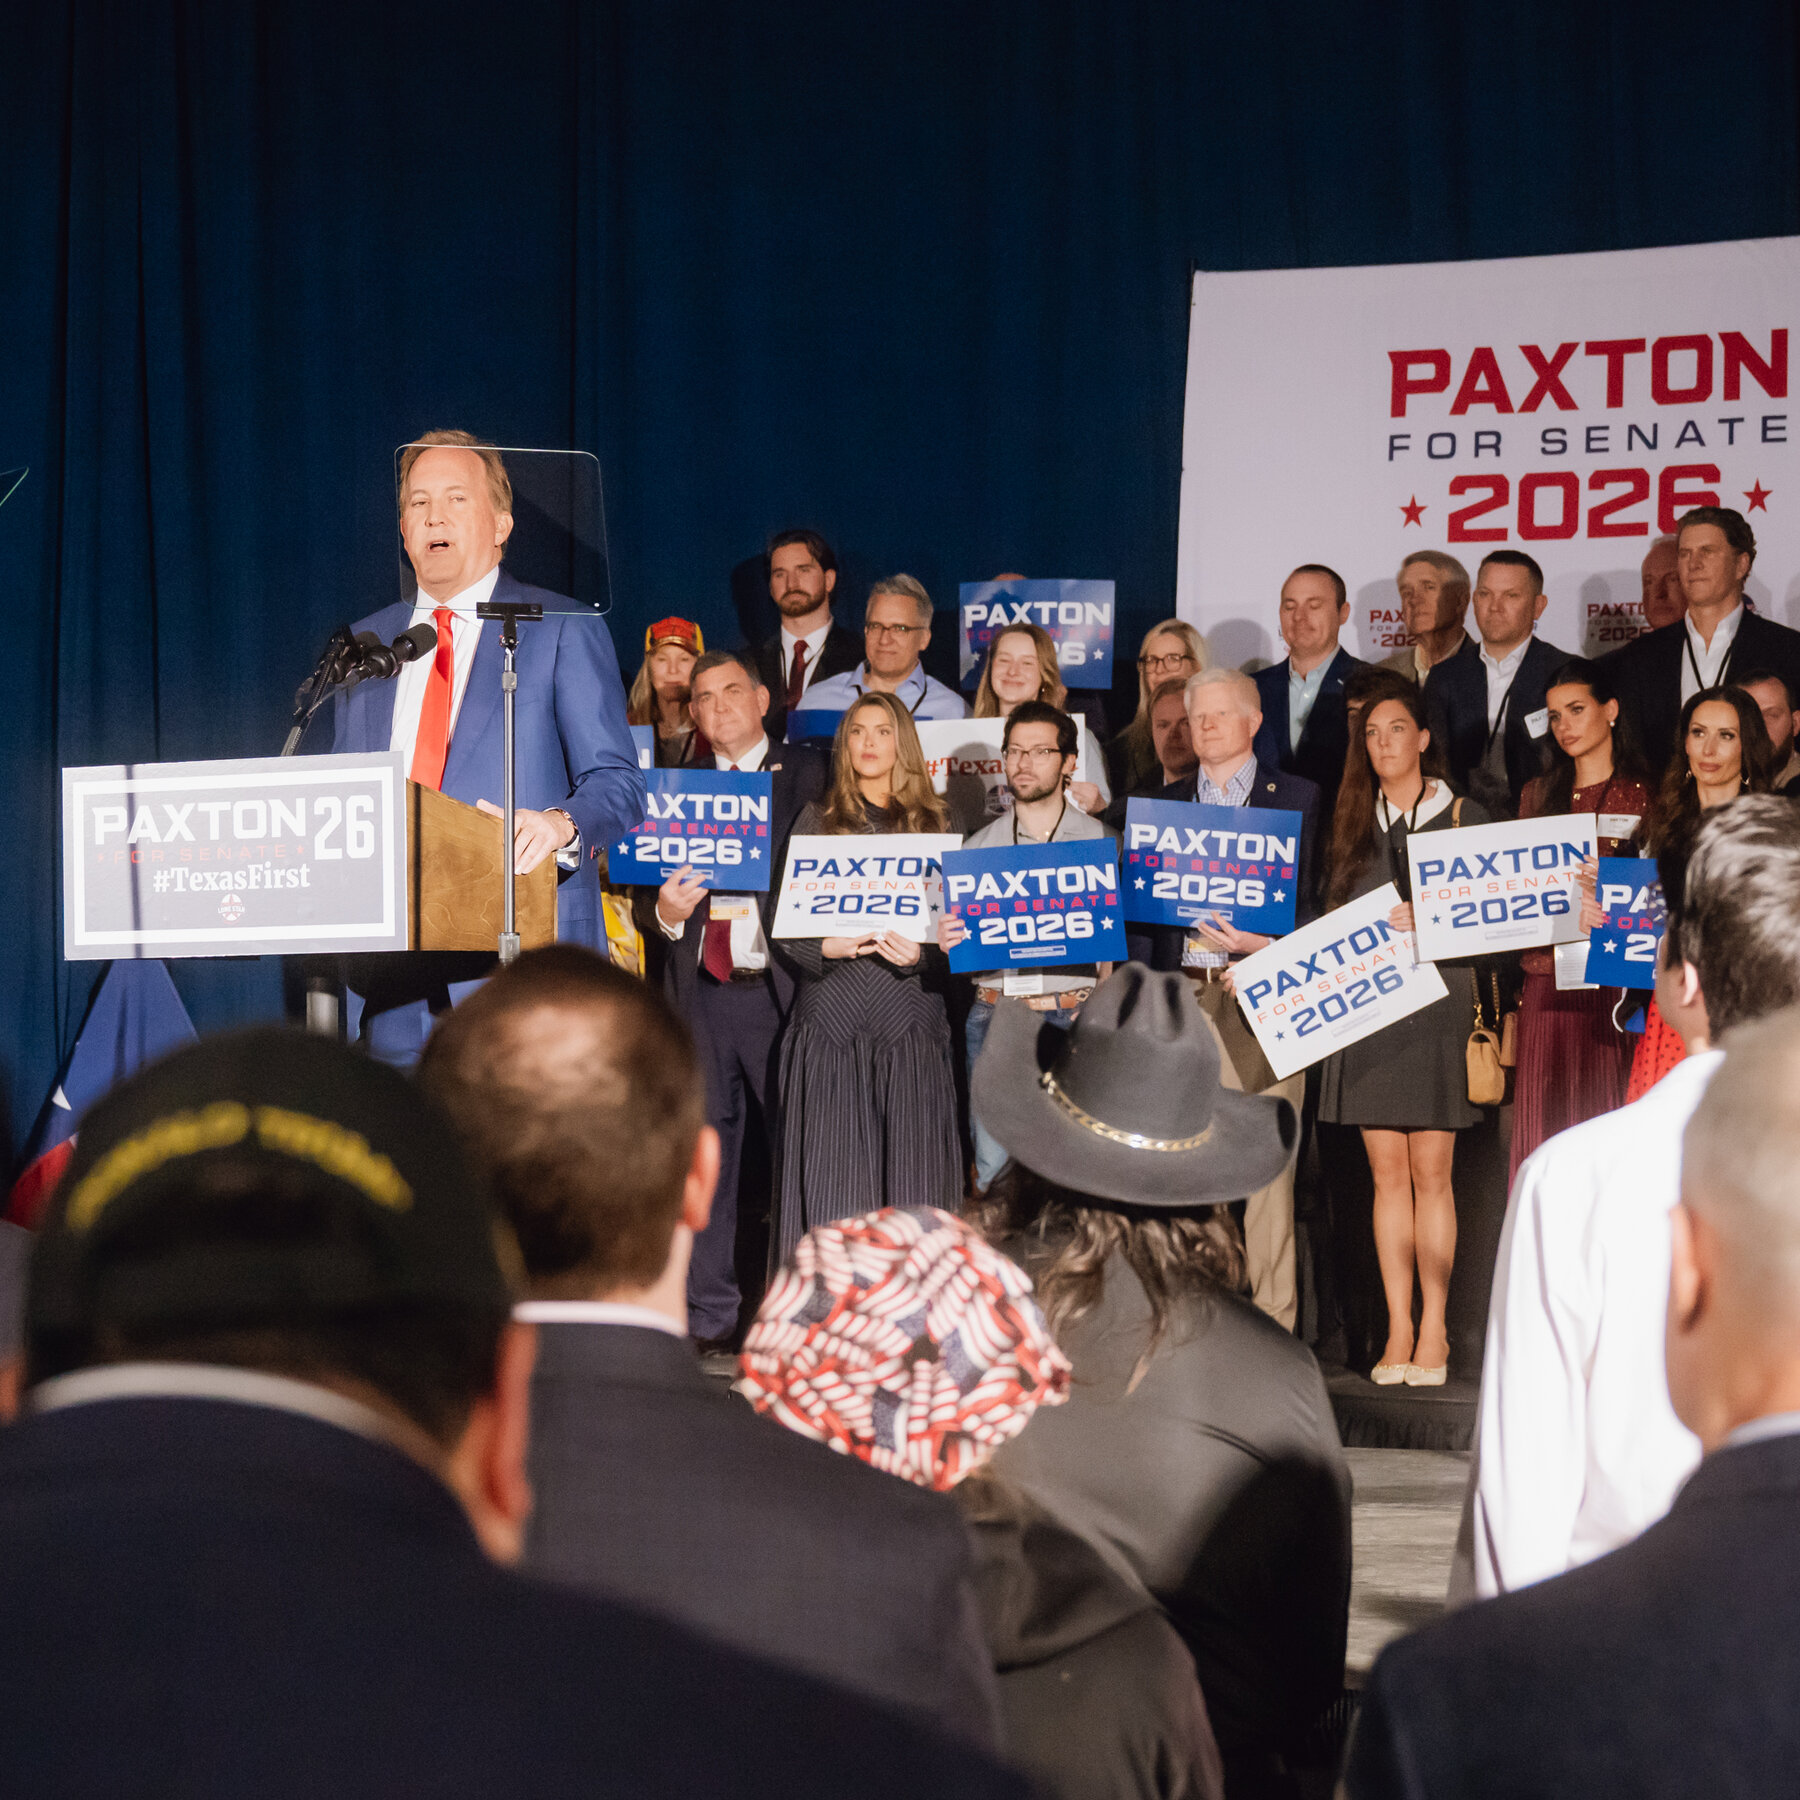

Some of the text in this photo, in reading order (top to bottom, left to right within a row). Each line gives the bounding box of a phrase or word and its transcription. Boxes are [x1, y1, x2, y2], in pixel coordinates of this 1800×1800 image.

[1388, 328, 1789, 418] PAXTON
[1388, 415, 1788, 461] FOR SENATE
[1447, 463, 1721, 543] 2026
[963, 601, 1111, 628] PAXTON
[1369, 609, 1404, 623] PAX
[1380, 633, 1417, 648] 202
[926, 756, 1004, 777] #Texa
[646, 792, 769, 822] AXTON
[92, 794, 375, 861] PAXTON 26
[669, 822, 768, 837] SENATE
[113, 844, 287, 865] FOR SENATE
[635, 836, 743, 865] 2026
[1130, 823, 1296, 864] PAXTON
[153, 861, 311, 893] #TexasFirst
[792, 857, 942, 878] PAXTON
[1129, 853, 1293, 879] FOR SENATE
[1416, 841, 1590, 886] PAXTON
[789, 881, 836, 892] FOR
[947, 863, 1117, 902] PAXTON
[1152, 871, 1266, 907] 2026
[1421, 871, 1575, 902] FOR SENAT
[810, 894, 921, 916] 2026
[951, 893, 1118, 916] FOR SENATE
[1450, 889, 1570, 928] 2026
[978, 911, 1094, 945] 2026
[1243, 919, 1397, 1010] PAXTON
[1256, 993, 1306, 1024] FOR
[1317, 937, 1417, 993] SENATE
[1290, 964, 1404, 1038] 2026
